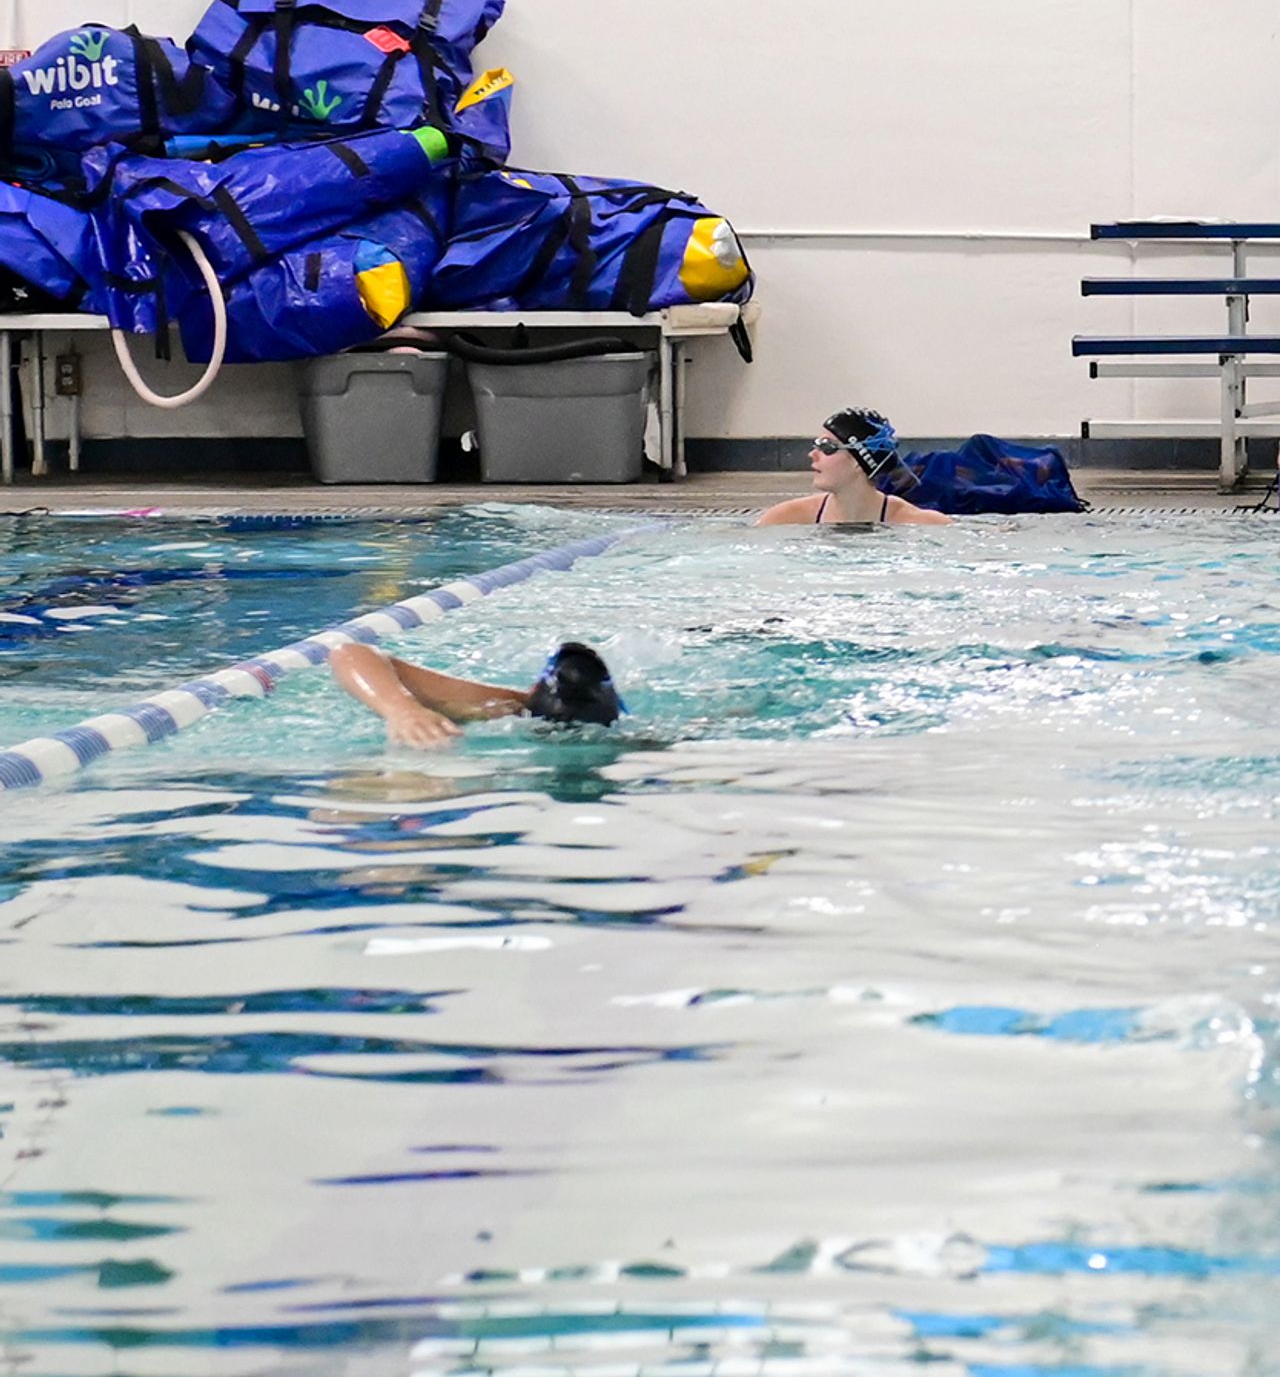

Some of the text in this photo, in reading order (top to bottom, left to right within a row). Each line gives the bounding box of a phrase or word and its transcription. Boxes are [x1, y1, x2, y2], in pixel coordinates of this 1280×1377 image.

[22, 54, 119, 96] wibit
[50, 94, 102, 111] Polo Goal
